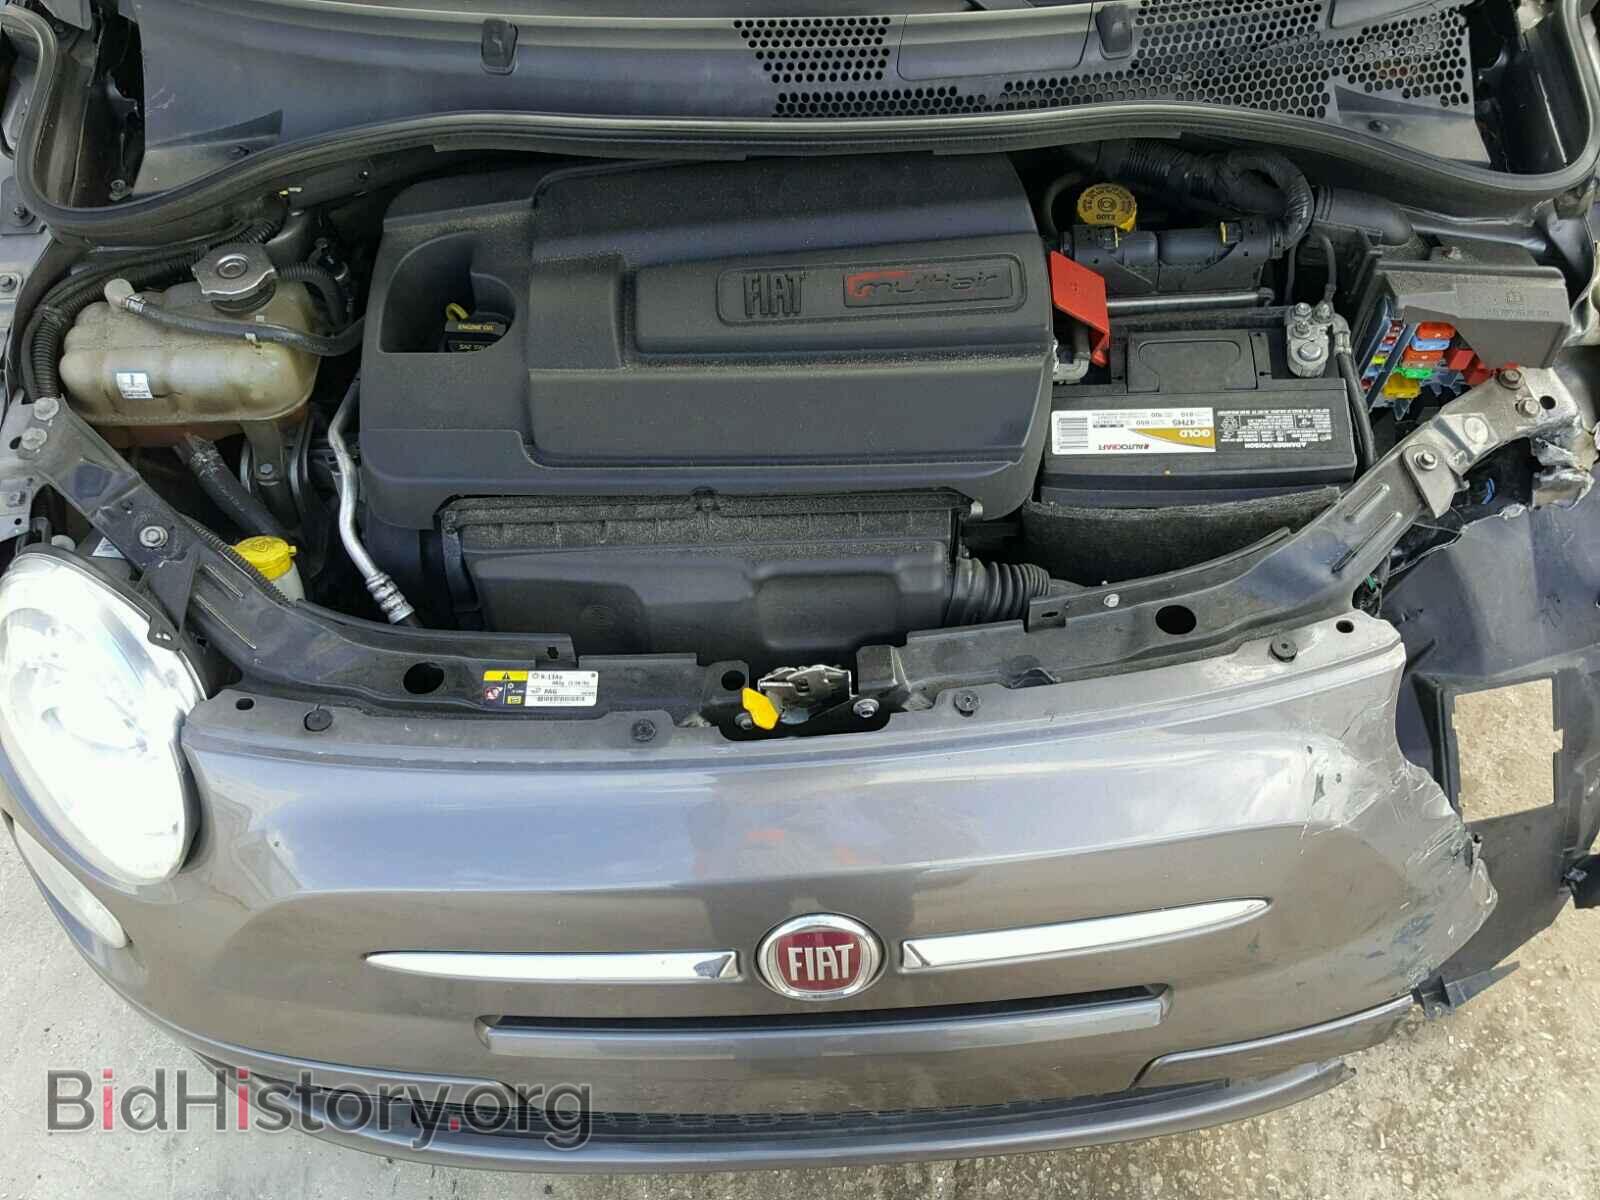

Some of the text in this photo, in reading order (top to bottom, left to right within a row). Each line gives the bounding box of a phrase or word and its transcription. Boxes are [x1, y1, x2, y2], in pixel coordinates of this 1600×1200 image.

[743, 272, 802, 318] FIAT
[1179, 429, 1211, 438] GOLD
[787, 943, 854, 981] FIAT
